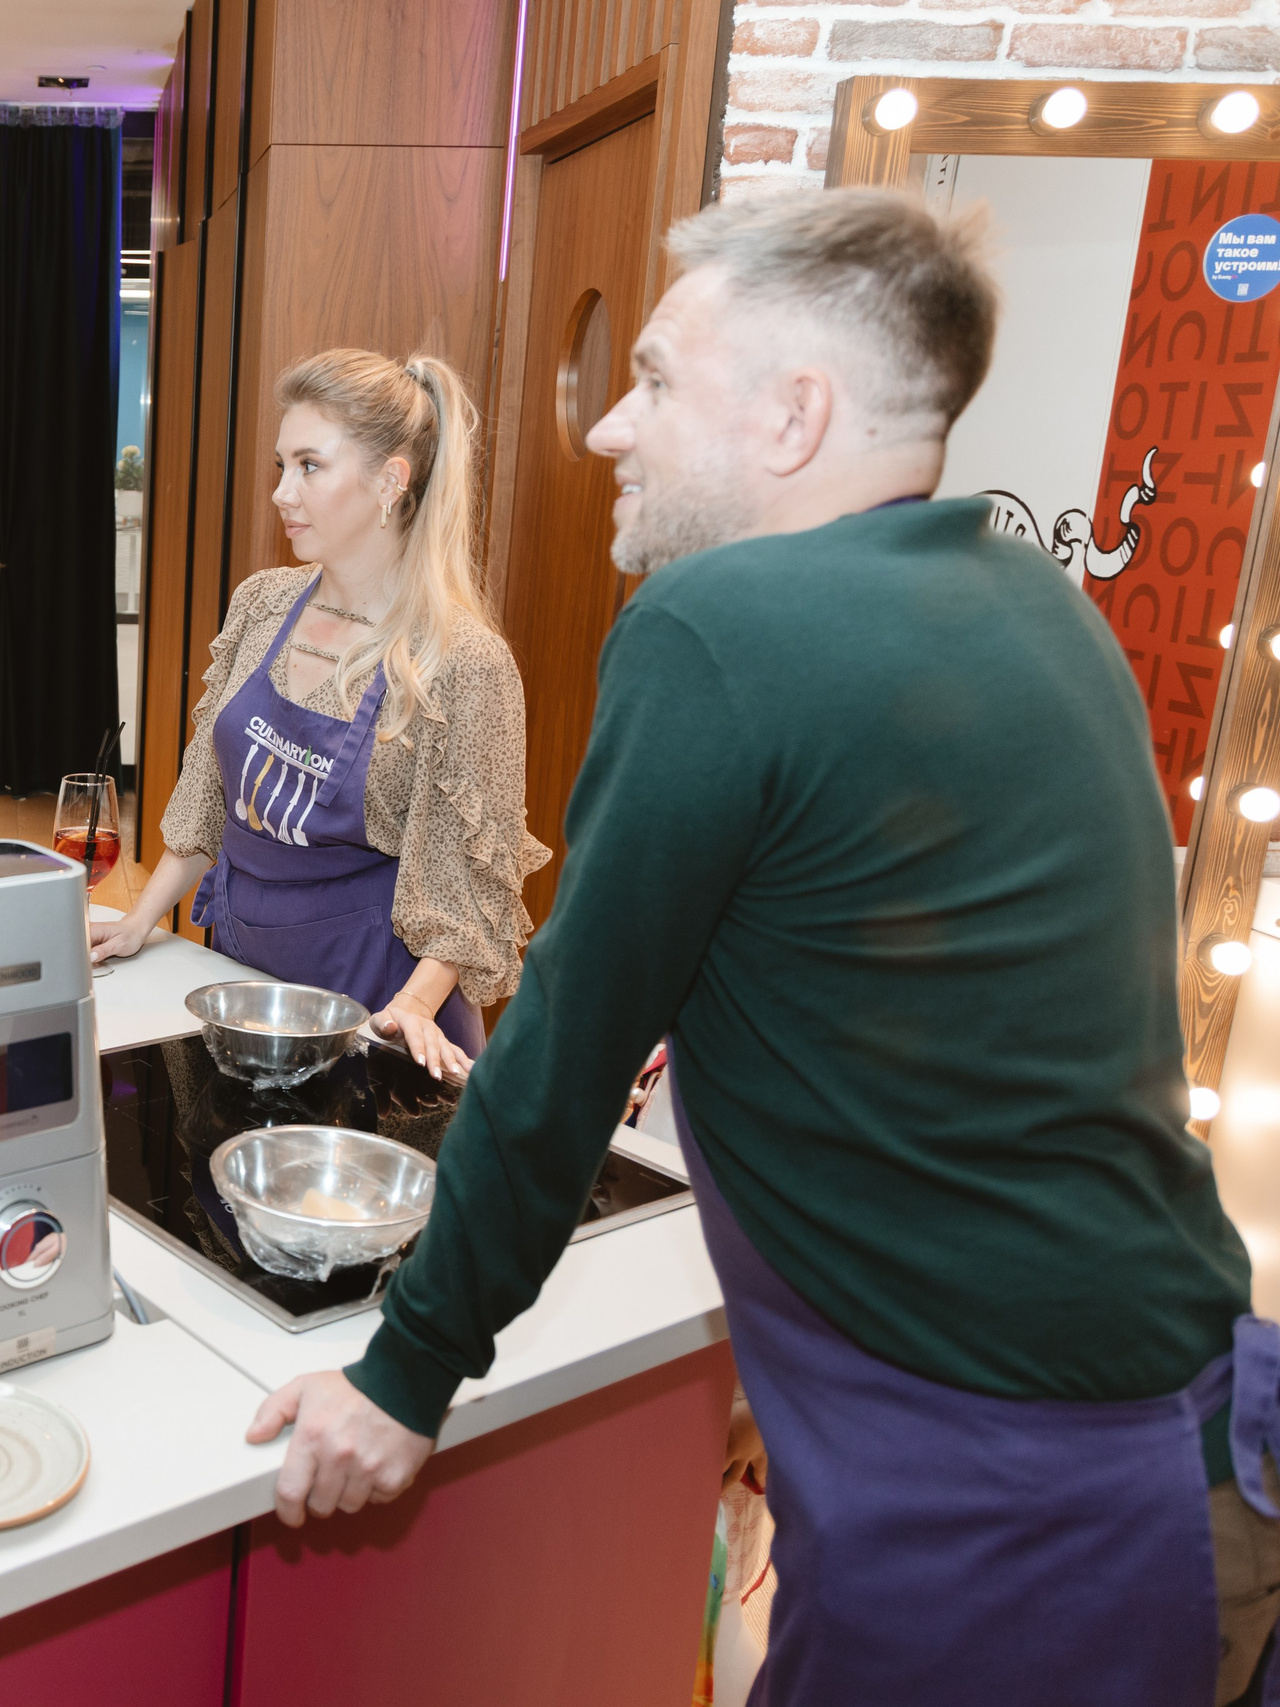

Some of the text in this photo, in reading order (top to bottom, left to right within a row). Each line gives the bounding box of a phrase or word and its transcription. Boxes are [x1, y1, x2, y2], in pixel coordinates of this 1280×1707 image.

[1218, 232, 1277, 245] Мы вам
[1216, 248, 1259, 258] такое
